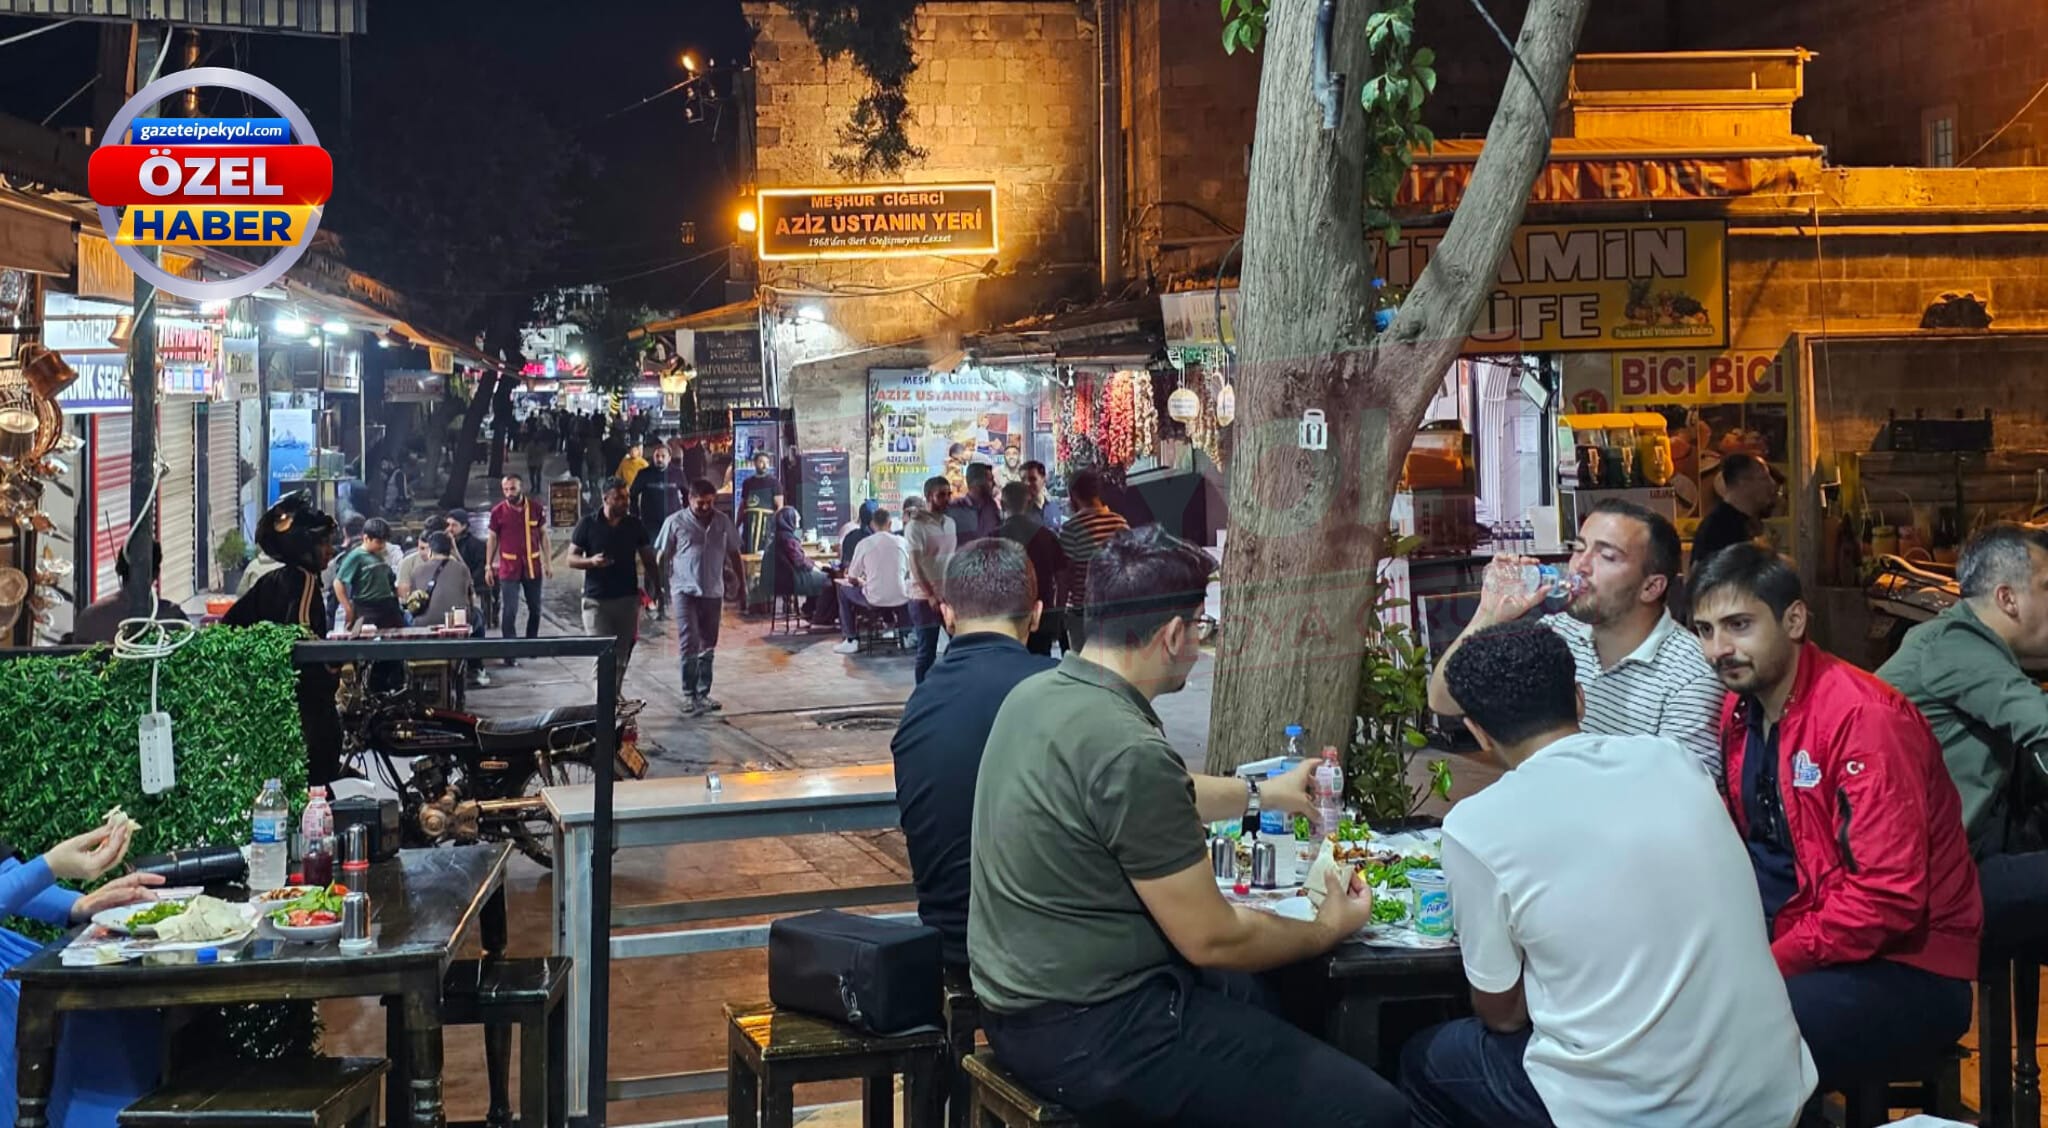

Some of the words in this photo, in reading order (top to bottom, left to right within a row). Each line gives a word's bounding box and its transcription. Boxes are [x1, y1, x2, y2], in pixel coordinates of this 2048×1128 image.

[811, 194, 875, 210] MEŞHUR
[775, 212, 826, 236] AZİZ
[831, 212, 926, 234] USTANIN
[931, 208, 983, 231] YERİ
[847, 236, 866, 246] Beri
[1470, 290, 1601, 342] ÜFE
[903, 375, 946, 386] MEŞHR
[875, 386, 911, 401] AZİZ
